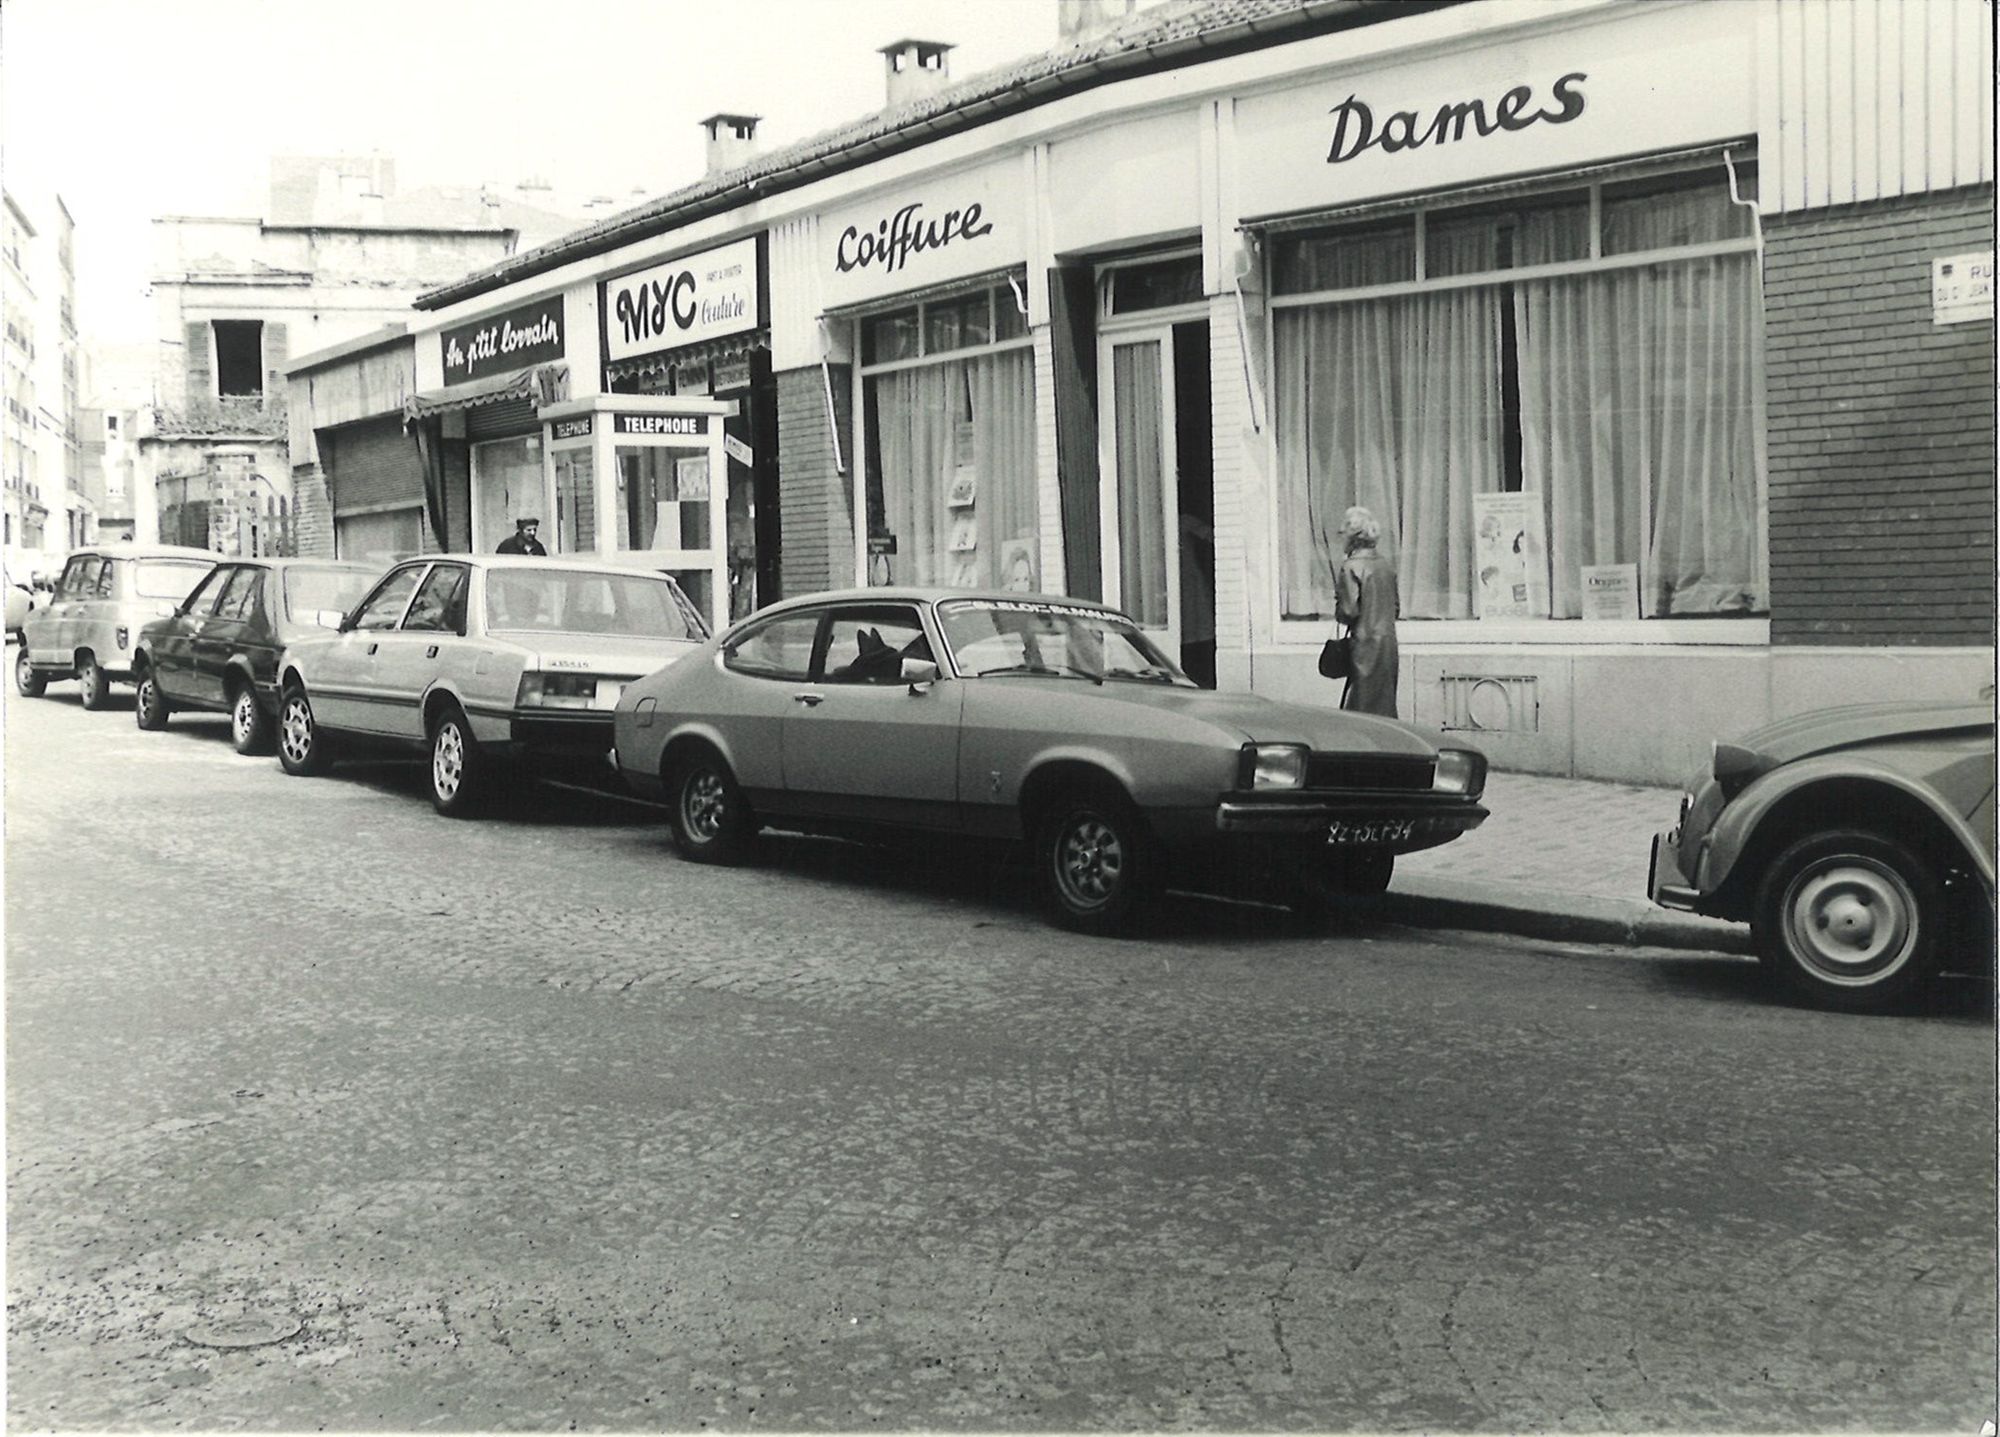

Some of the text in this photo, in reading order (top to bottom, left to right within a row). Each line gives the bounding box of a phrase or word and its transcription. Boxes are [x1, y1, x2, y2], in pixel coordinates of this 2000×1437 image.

[1326, 72, 1588, 164] Dames
[835, 203, 993, 273] Coiffure
[616, 270, 697, 344] MYC
[702, 292, 745, 325] Couture
[446, 338, 465, 367] Au
[467, 326, 498, 374] p'tit
[556, 419, 590, 438] TELEPHONE
[624, 417, 697, 434] TELEPHONE
